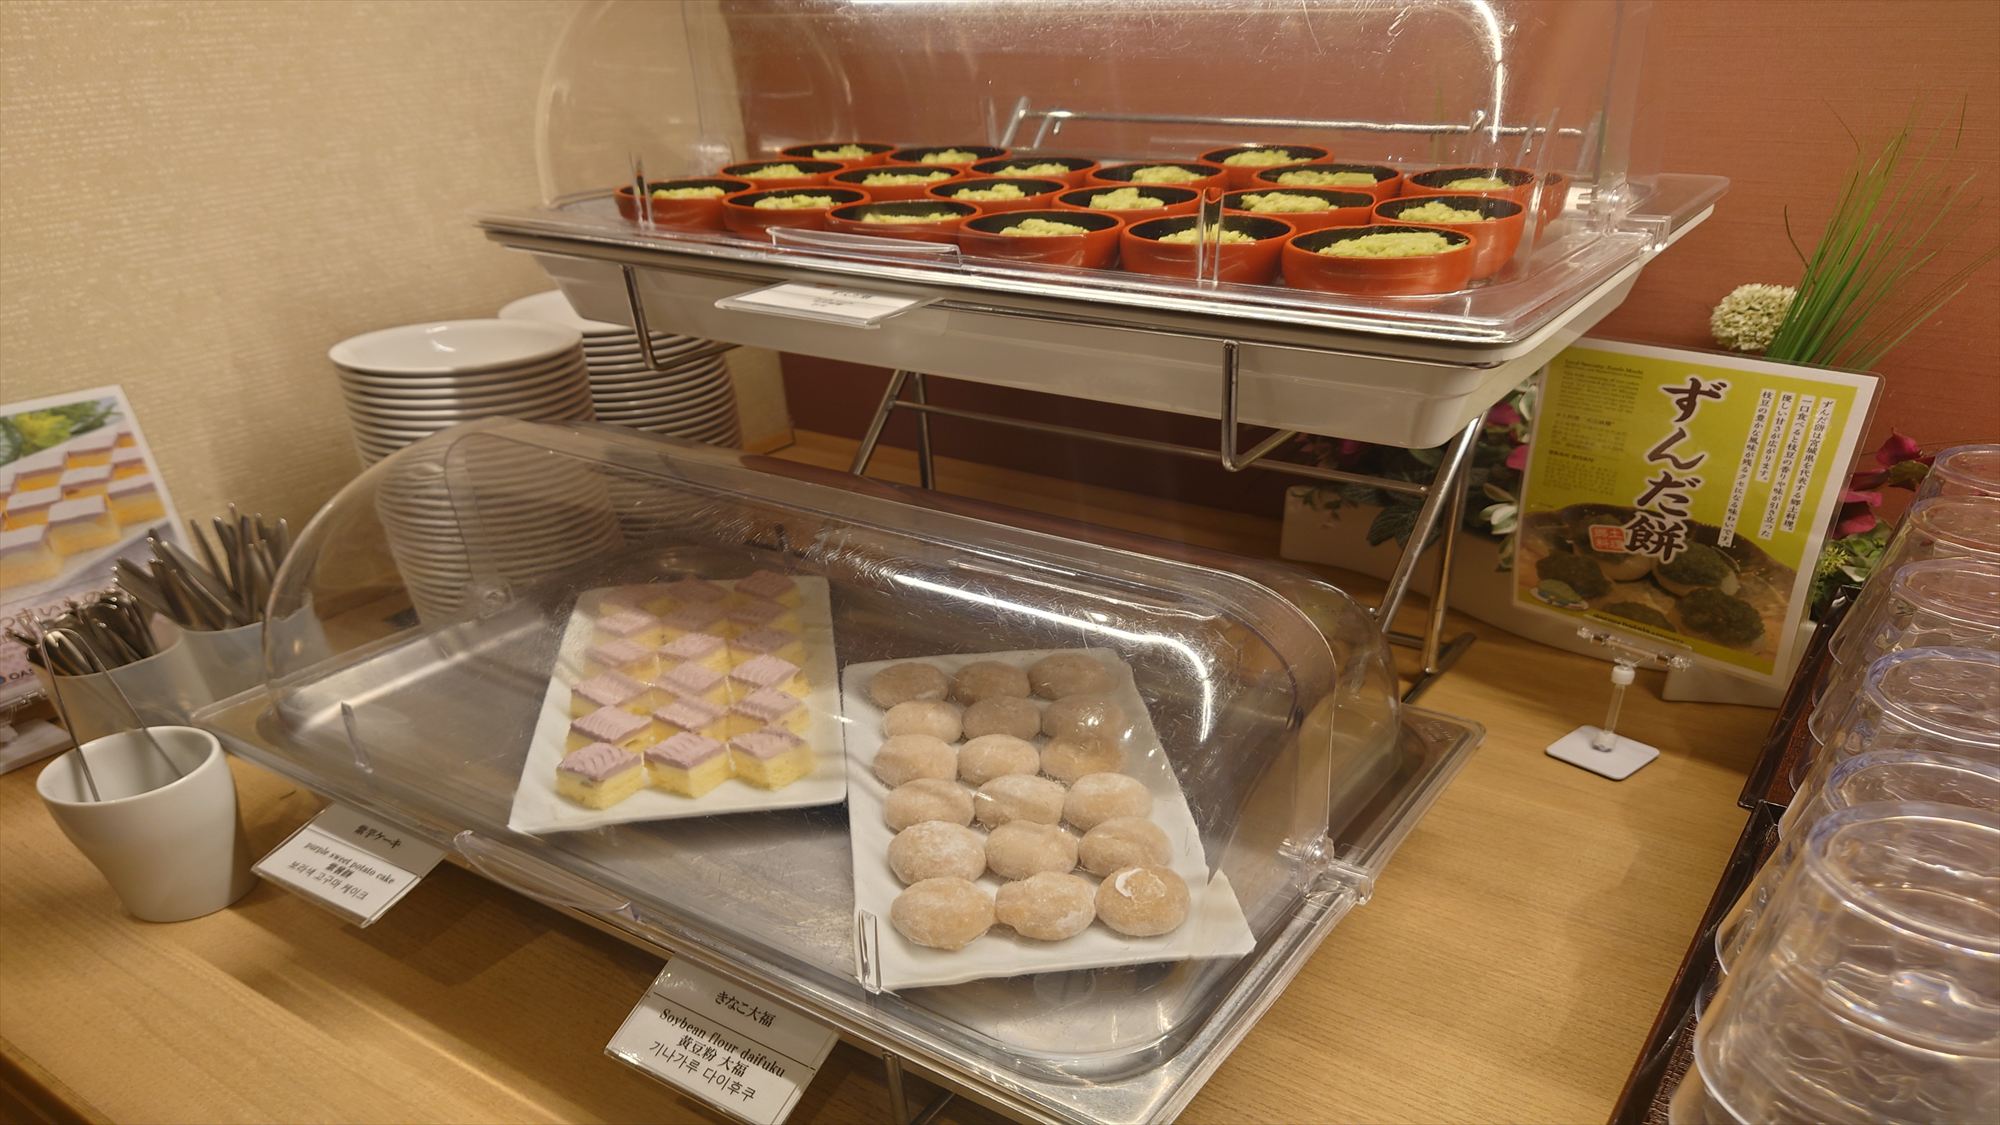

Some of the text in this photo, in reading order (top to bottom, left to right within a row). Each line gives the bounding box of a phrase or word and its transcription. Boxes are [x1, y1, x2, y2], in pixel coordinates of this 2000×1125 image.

[1625, 377, 1728, 561] ずんだ餅
[304, 842, 330, 856] purple
[329, 852, 353, 865] sweet
[349, 861, 377, 877] potato
[375, 873, 396, 885] cake
[714, 991, 776, 1028] きなこ大福
[659, 1008, 786, 1078] Soybean flour daifuku
[720, 1058, 750, 1078] 大福
[649, 1041, 757, 1101] 기나가루 다이후쿠
